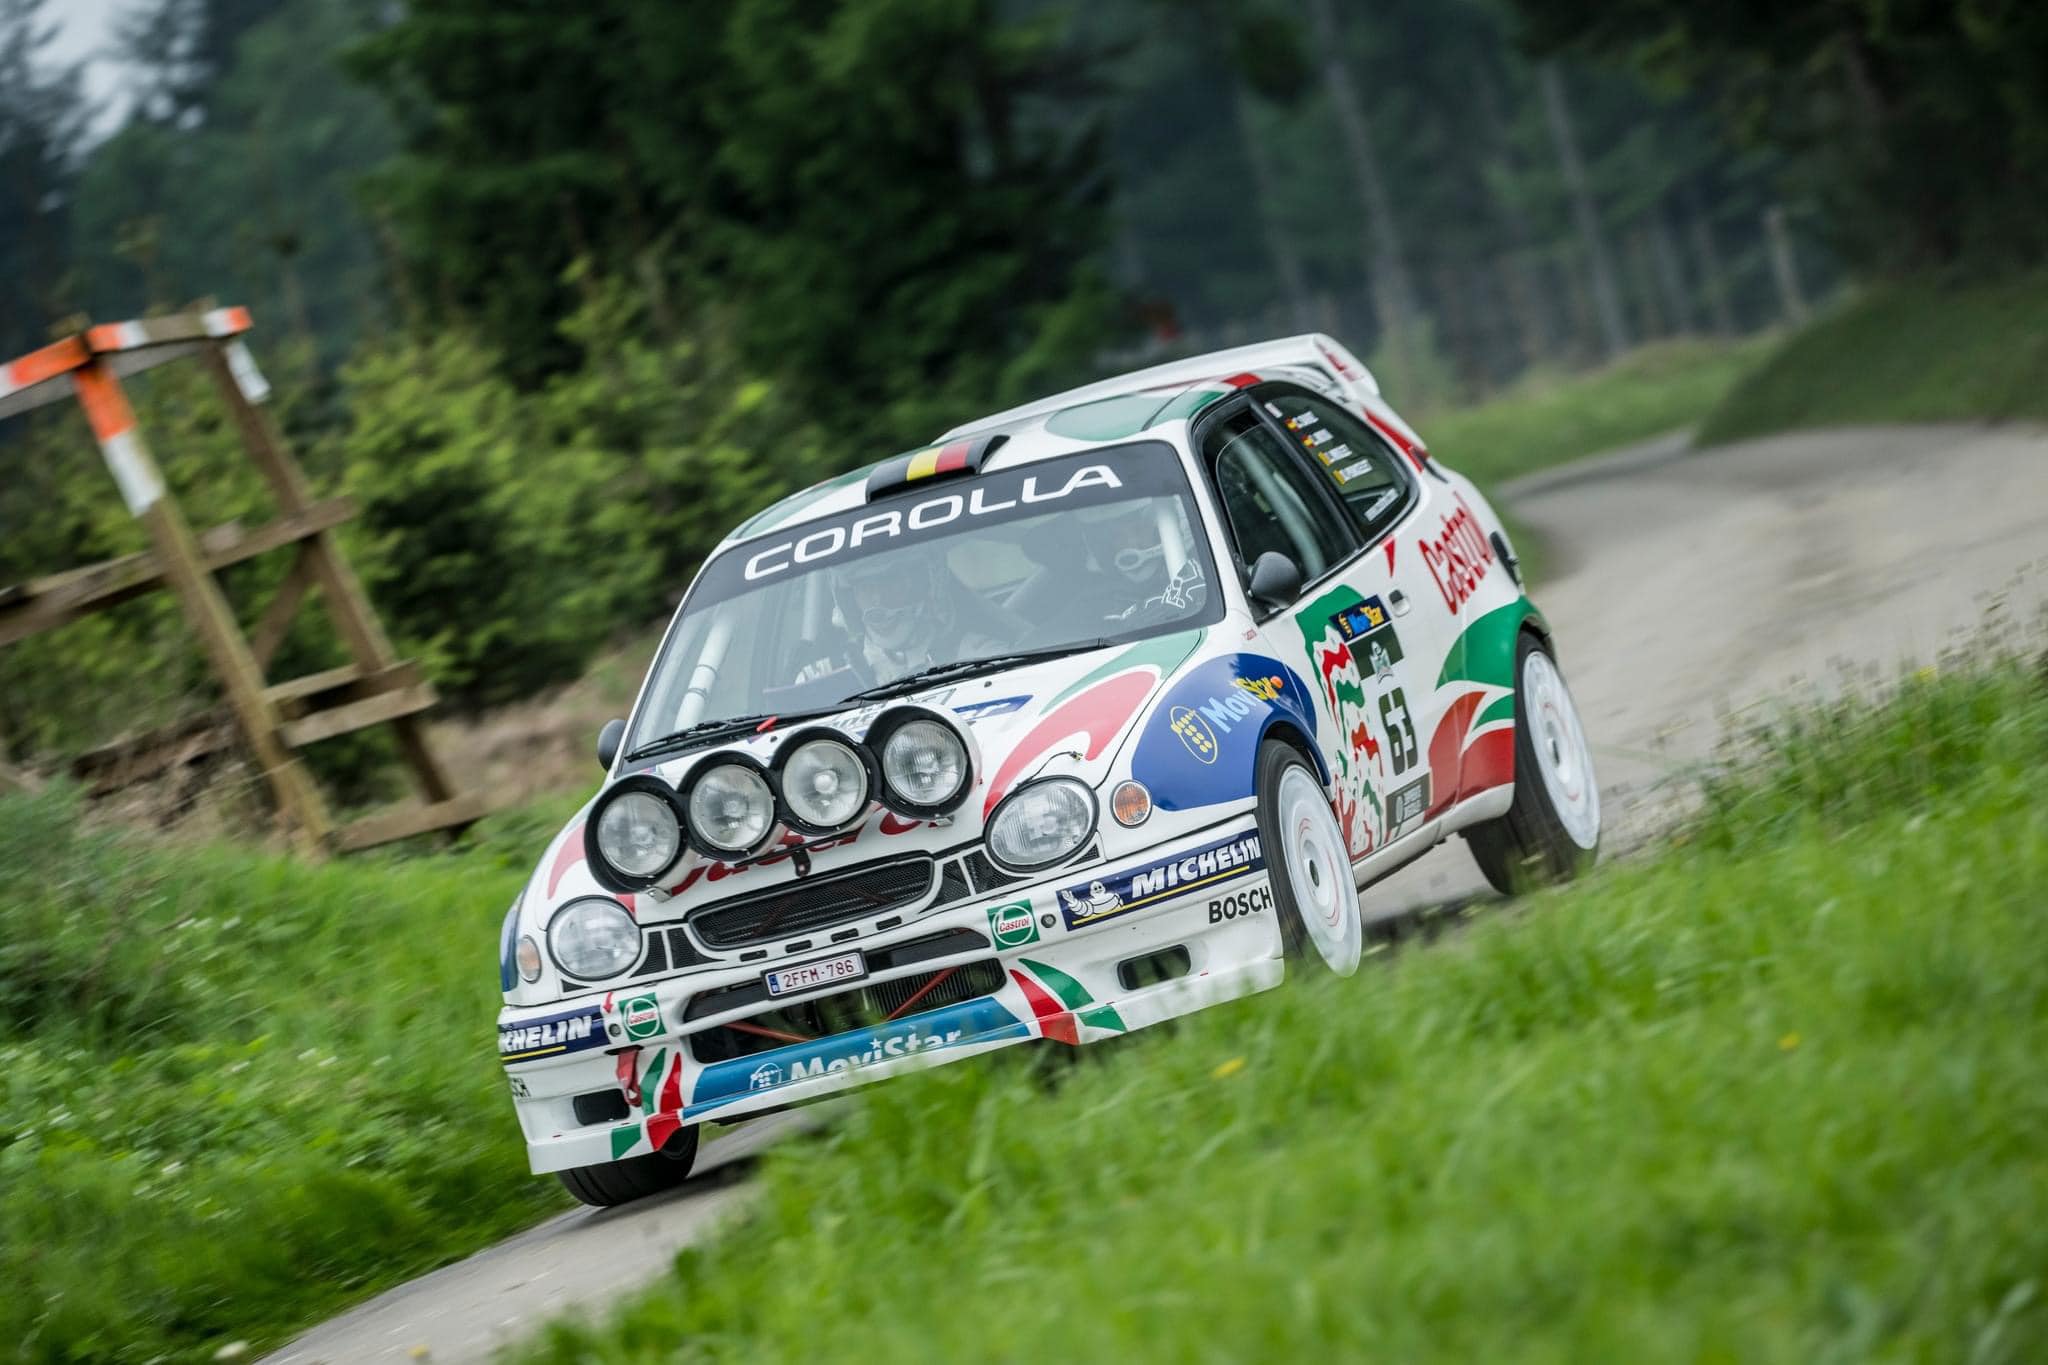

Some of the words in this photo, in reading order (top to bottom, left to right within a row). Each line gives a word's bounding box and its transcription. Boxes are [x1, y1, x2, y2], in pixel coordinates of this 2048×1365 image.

[745, 465, 1123, 582] COROLLA
[1132, 836, 1261, 899] MICHELIN
[1209, 885, 1273, 924] BOSCH
[1000, 917, 1030, 932] Castrol
[783, 959, 855, 988] 2FFM-786
